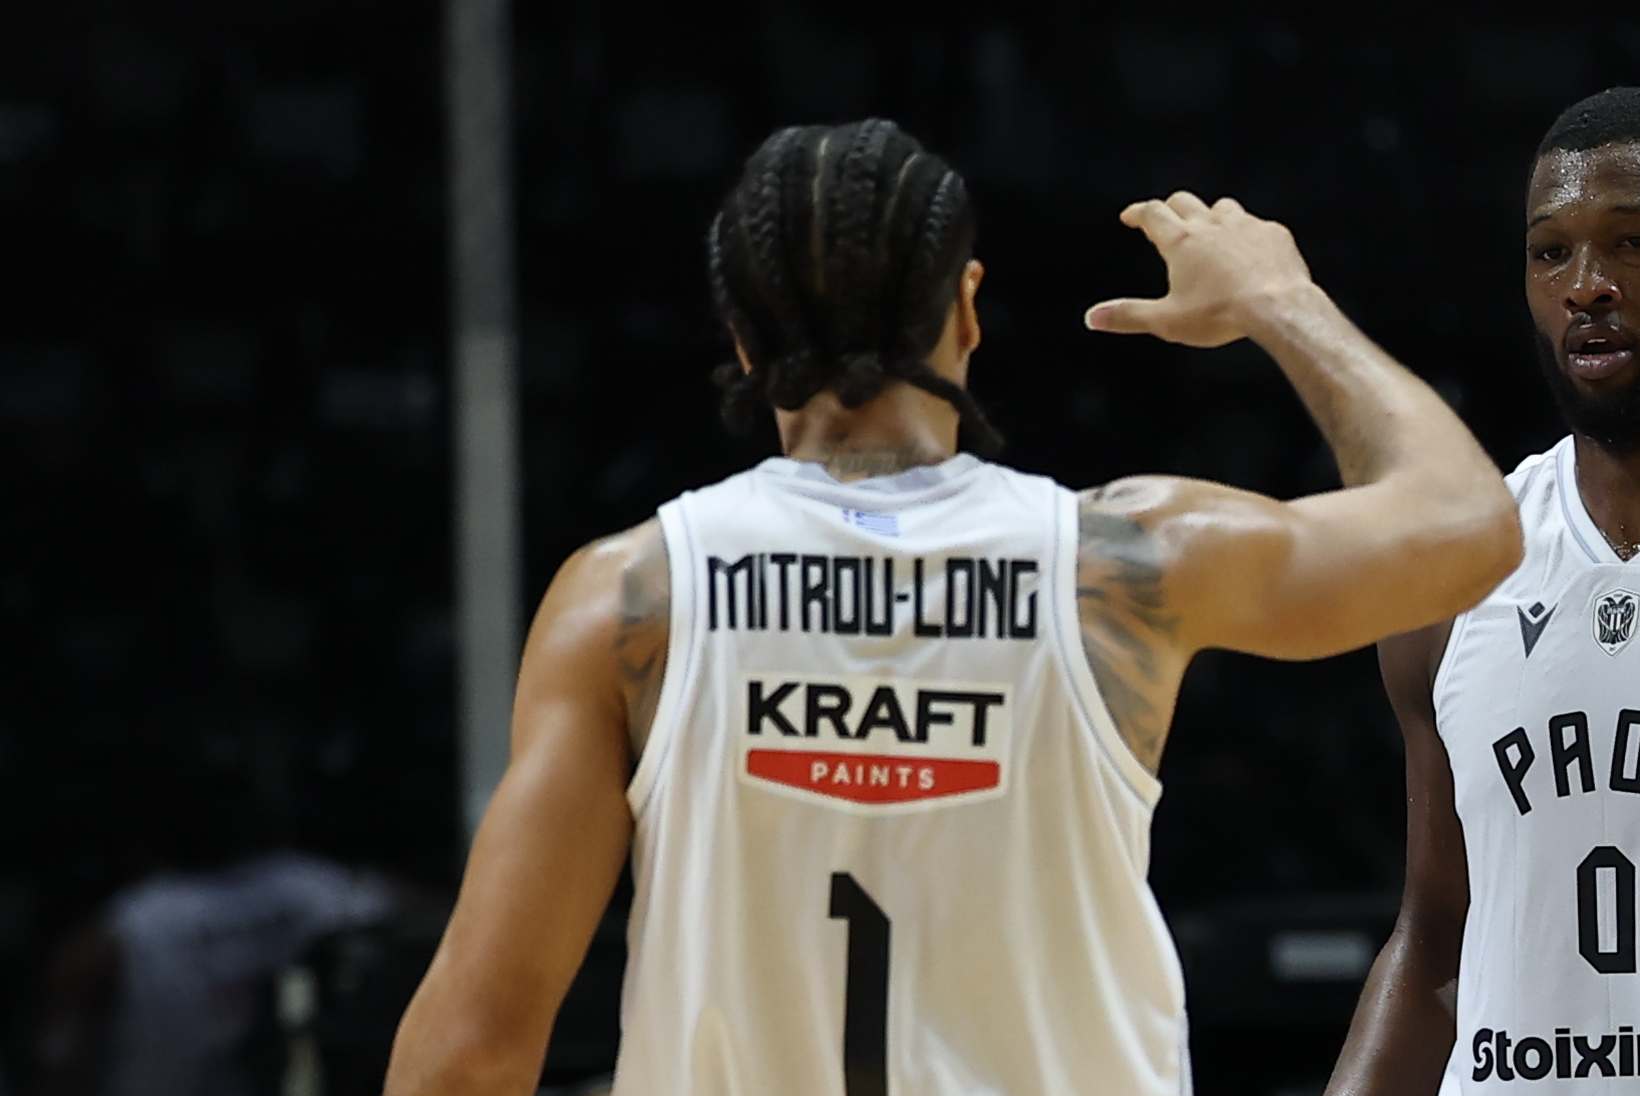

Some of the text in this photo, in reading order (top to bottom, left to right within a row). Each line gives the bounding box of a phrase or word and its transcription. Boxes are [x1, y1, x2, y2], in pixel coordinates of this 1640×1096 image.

[707, 553, 1039, 640] MITROU-LONG
[746, 680, 1005, 747] KRAFT
[809, 760, 936, 790] PAINTS
[1576, 845, 1638, 974] 0
